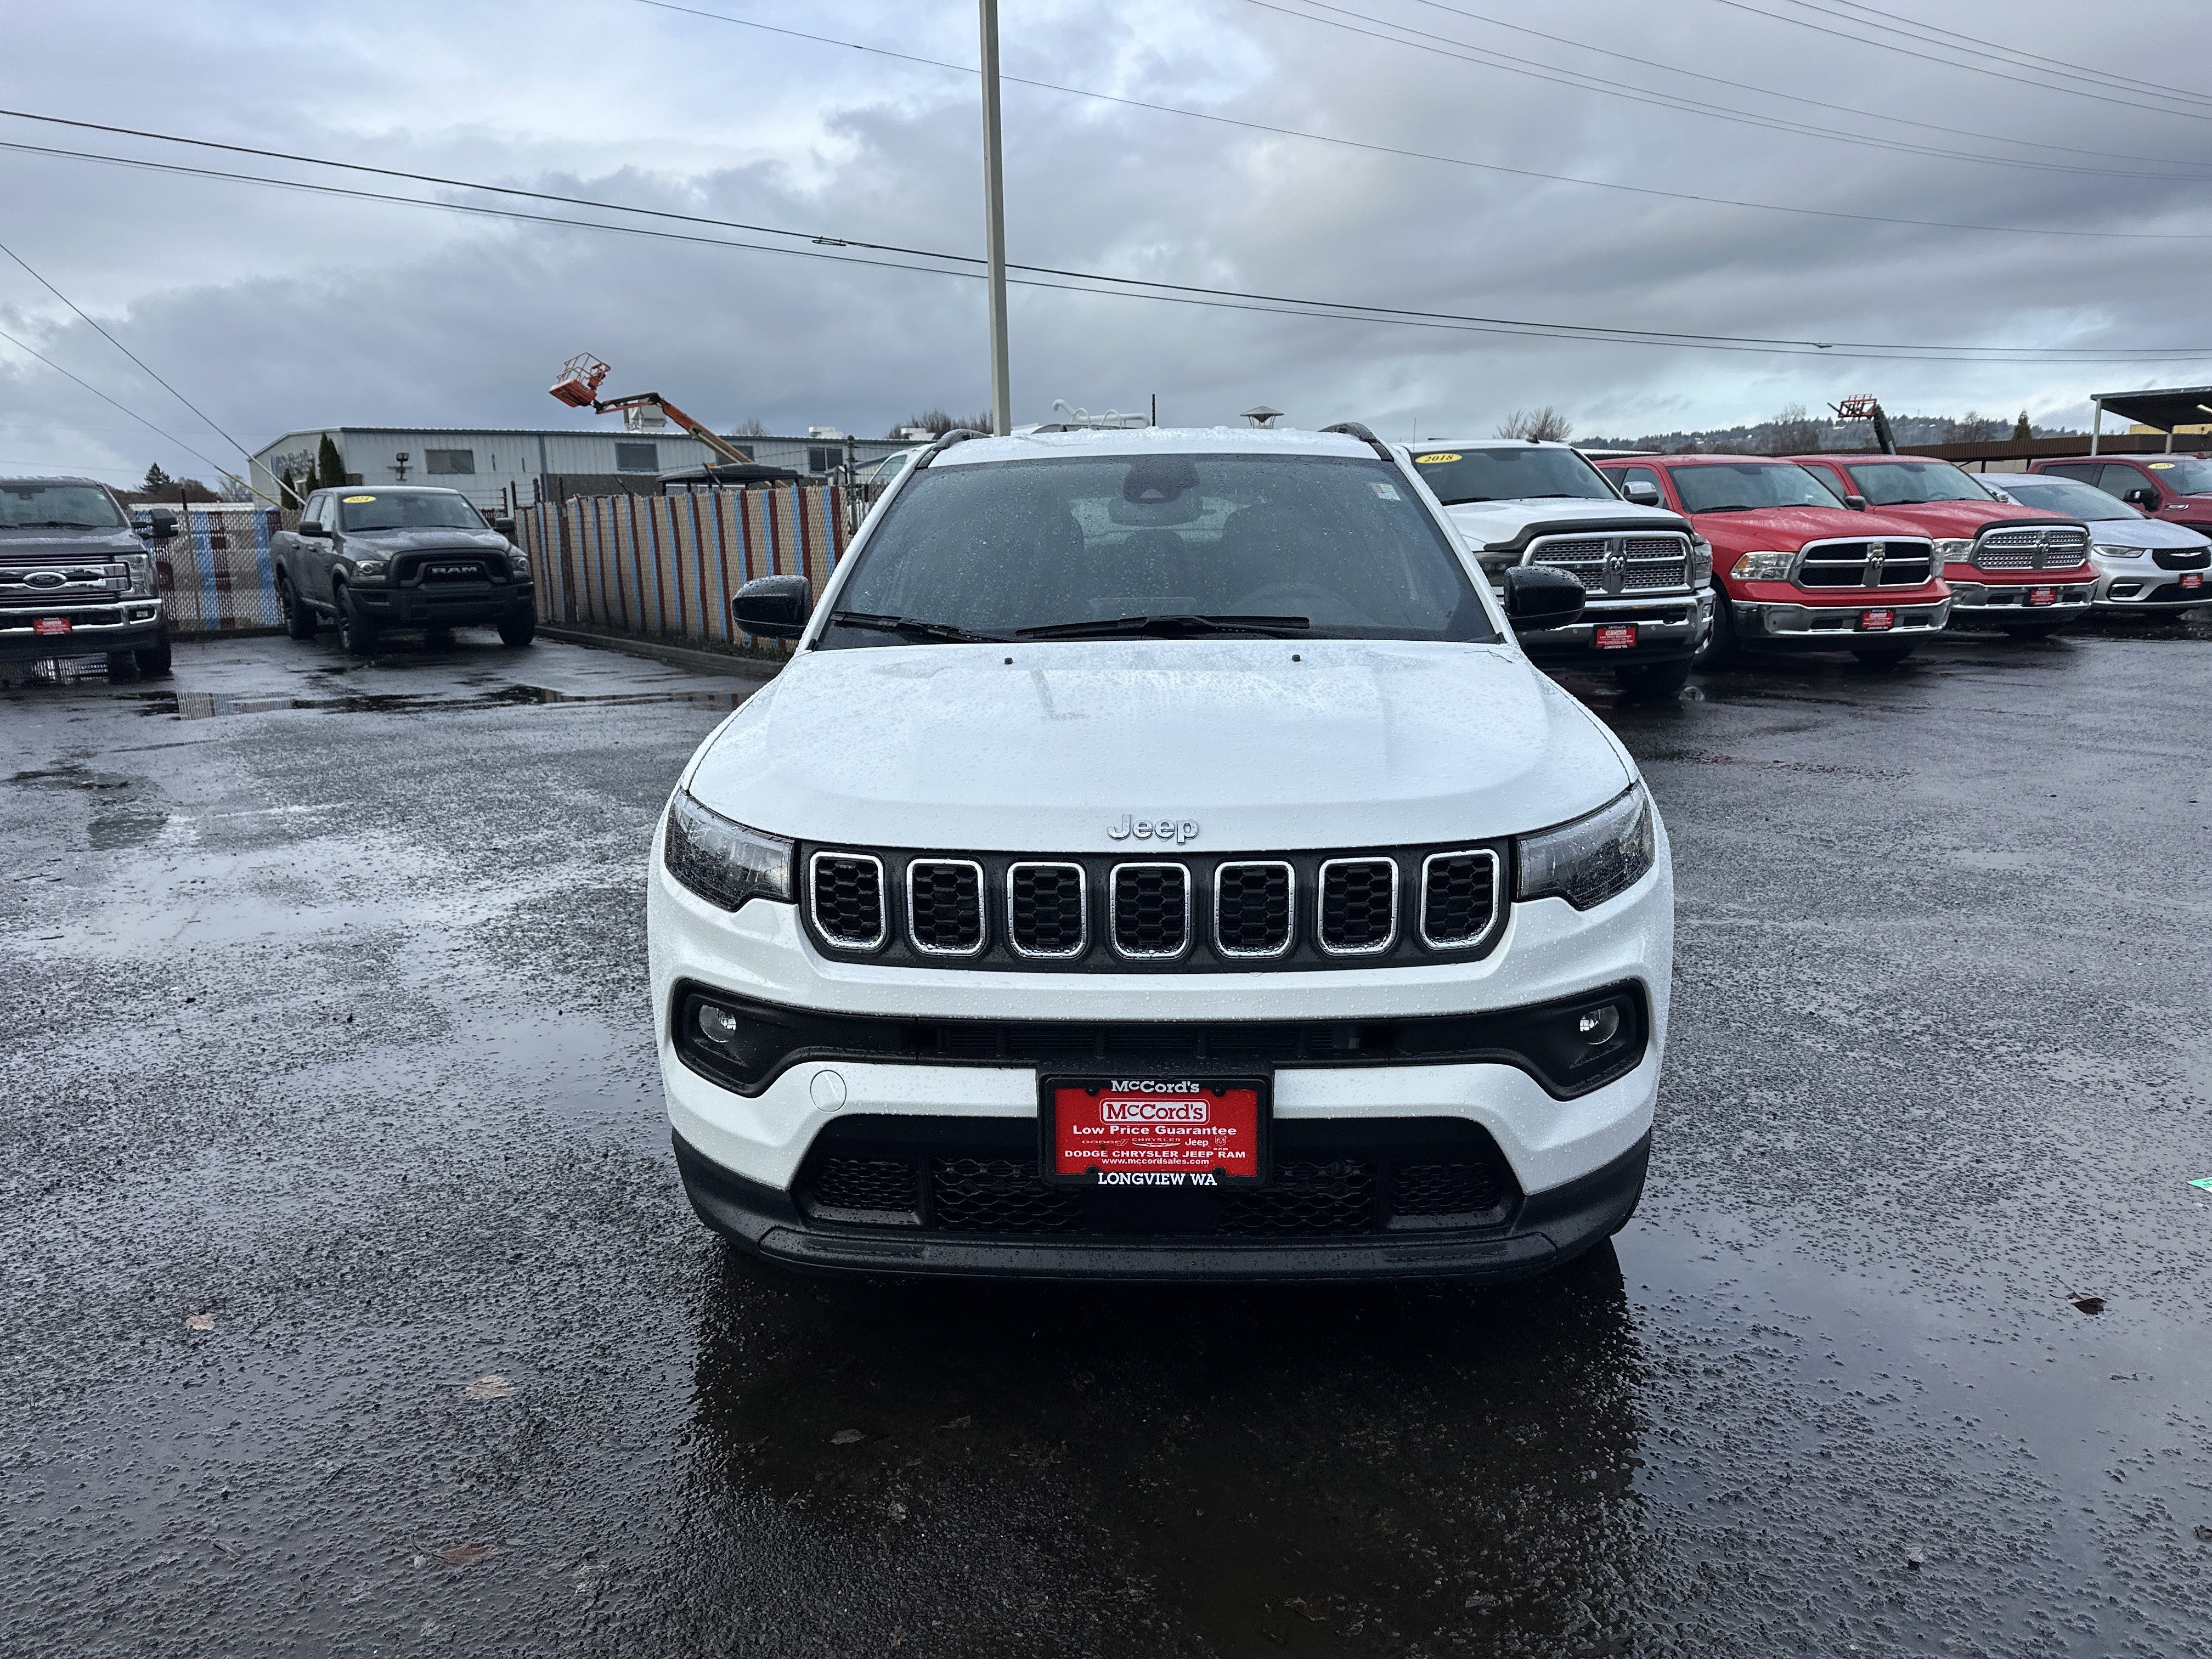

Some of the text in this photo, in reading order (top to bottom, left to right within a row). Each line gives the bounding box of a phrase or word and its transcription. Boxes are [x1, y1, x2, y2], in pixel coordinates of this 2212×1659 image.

[1424, 454, 1454, 462] 2018
[1107, 814, 1199, 845] Jeep
[1111, 1080, 1200, 1093] McCord's
[1106, 1103, 1204, 1120] McCord's
[1073, 1125, 1237, 1136] Low Price Guarantee
[1185, 1137, 1209, 1148] Jeep
[1098, 1172, 1217, 1186] LONGVIEW WA
